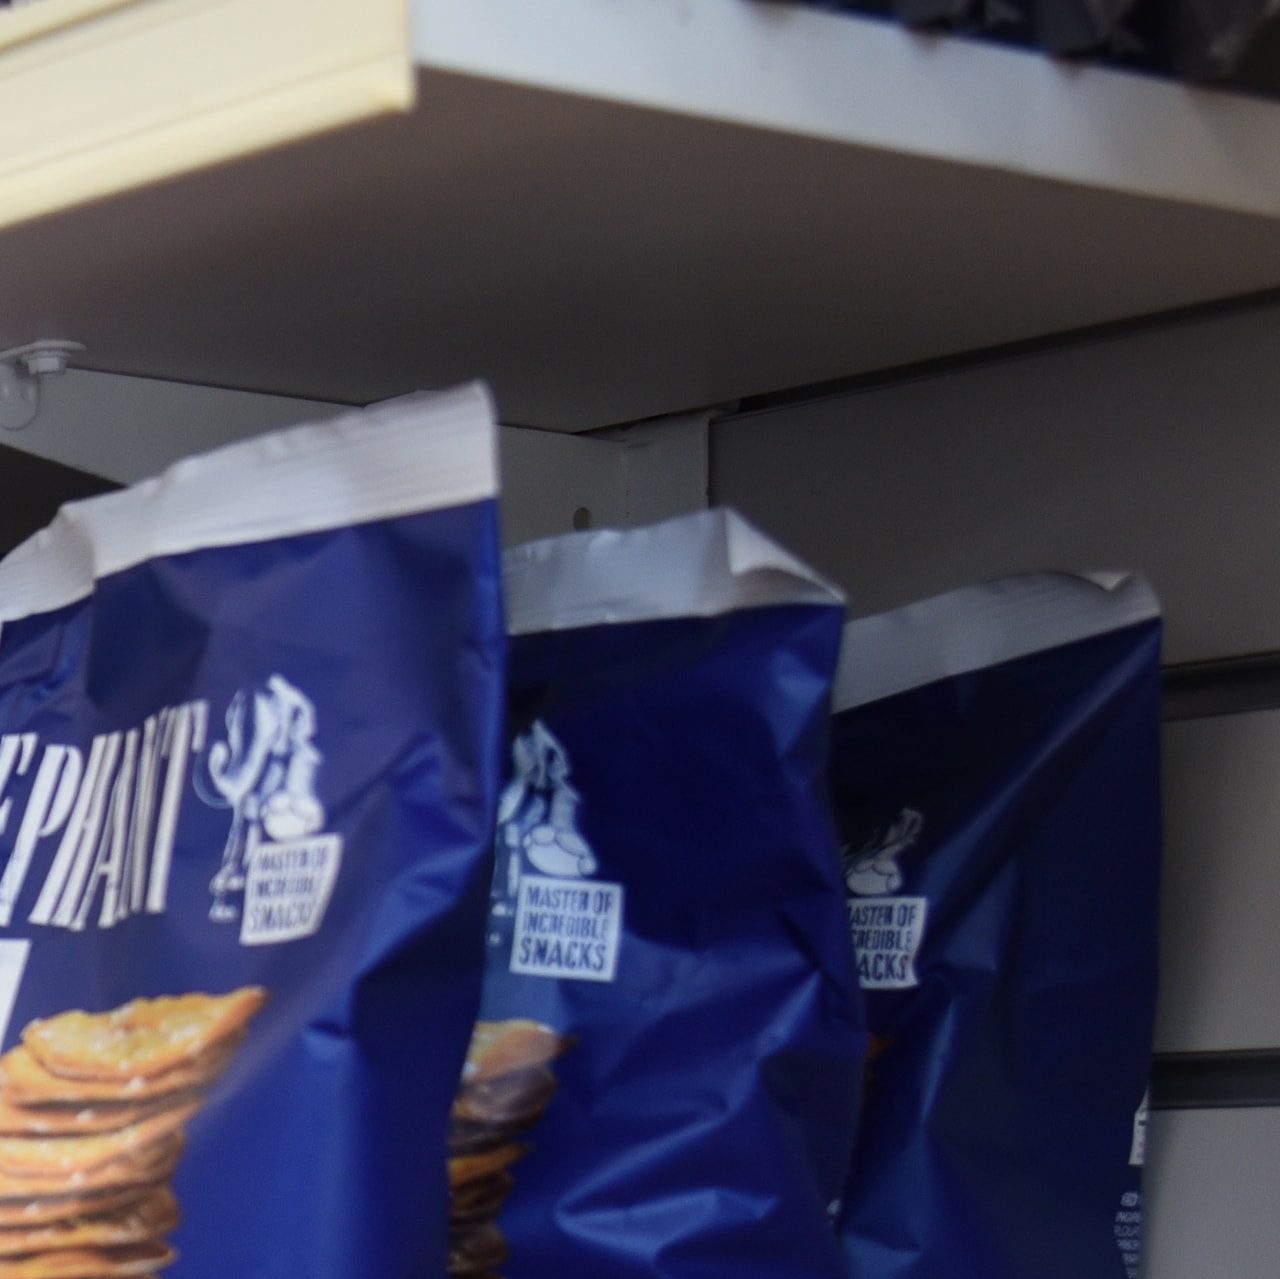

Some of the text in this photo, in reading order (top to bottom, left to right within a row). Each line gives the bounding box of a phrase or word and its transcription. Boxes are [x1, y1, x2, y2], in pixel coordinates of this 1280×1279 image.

[525, 883, 615, 914] MASTER OF
[522, 913, 608, 940] INCREDIBLE
[897, 904, 916, 927] OF
[851, 928, 912, 951] CREDIBLE
[518, 937, 607, 971] SNACKS
[857, 954, 909, 981] ACKS
